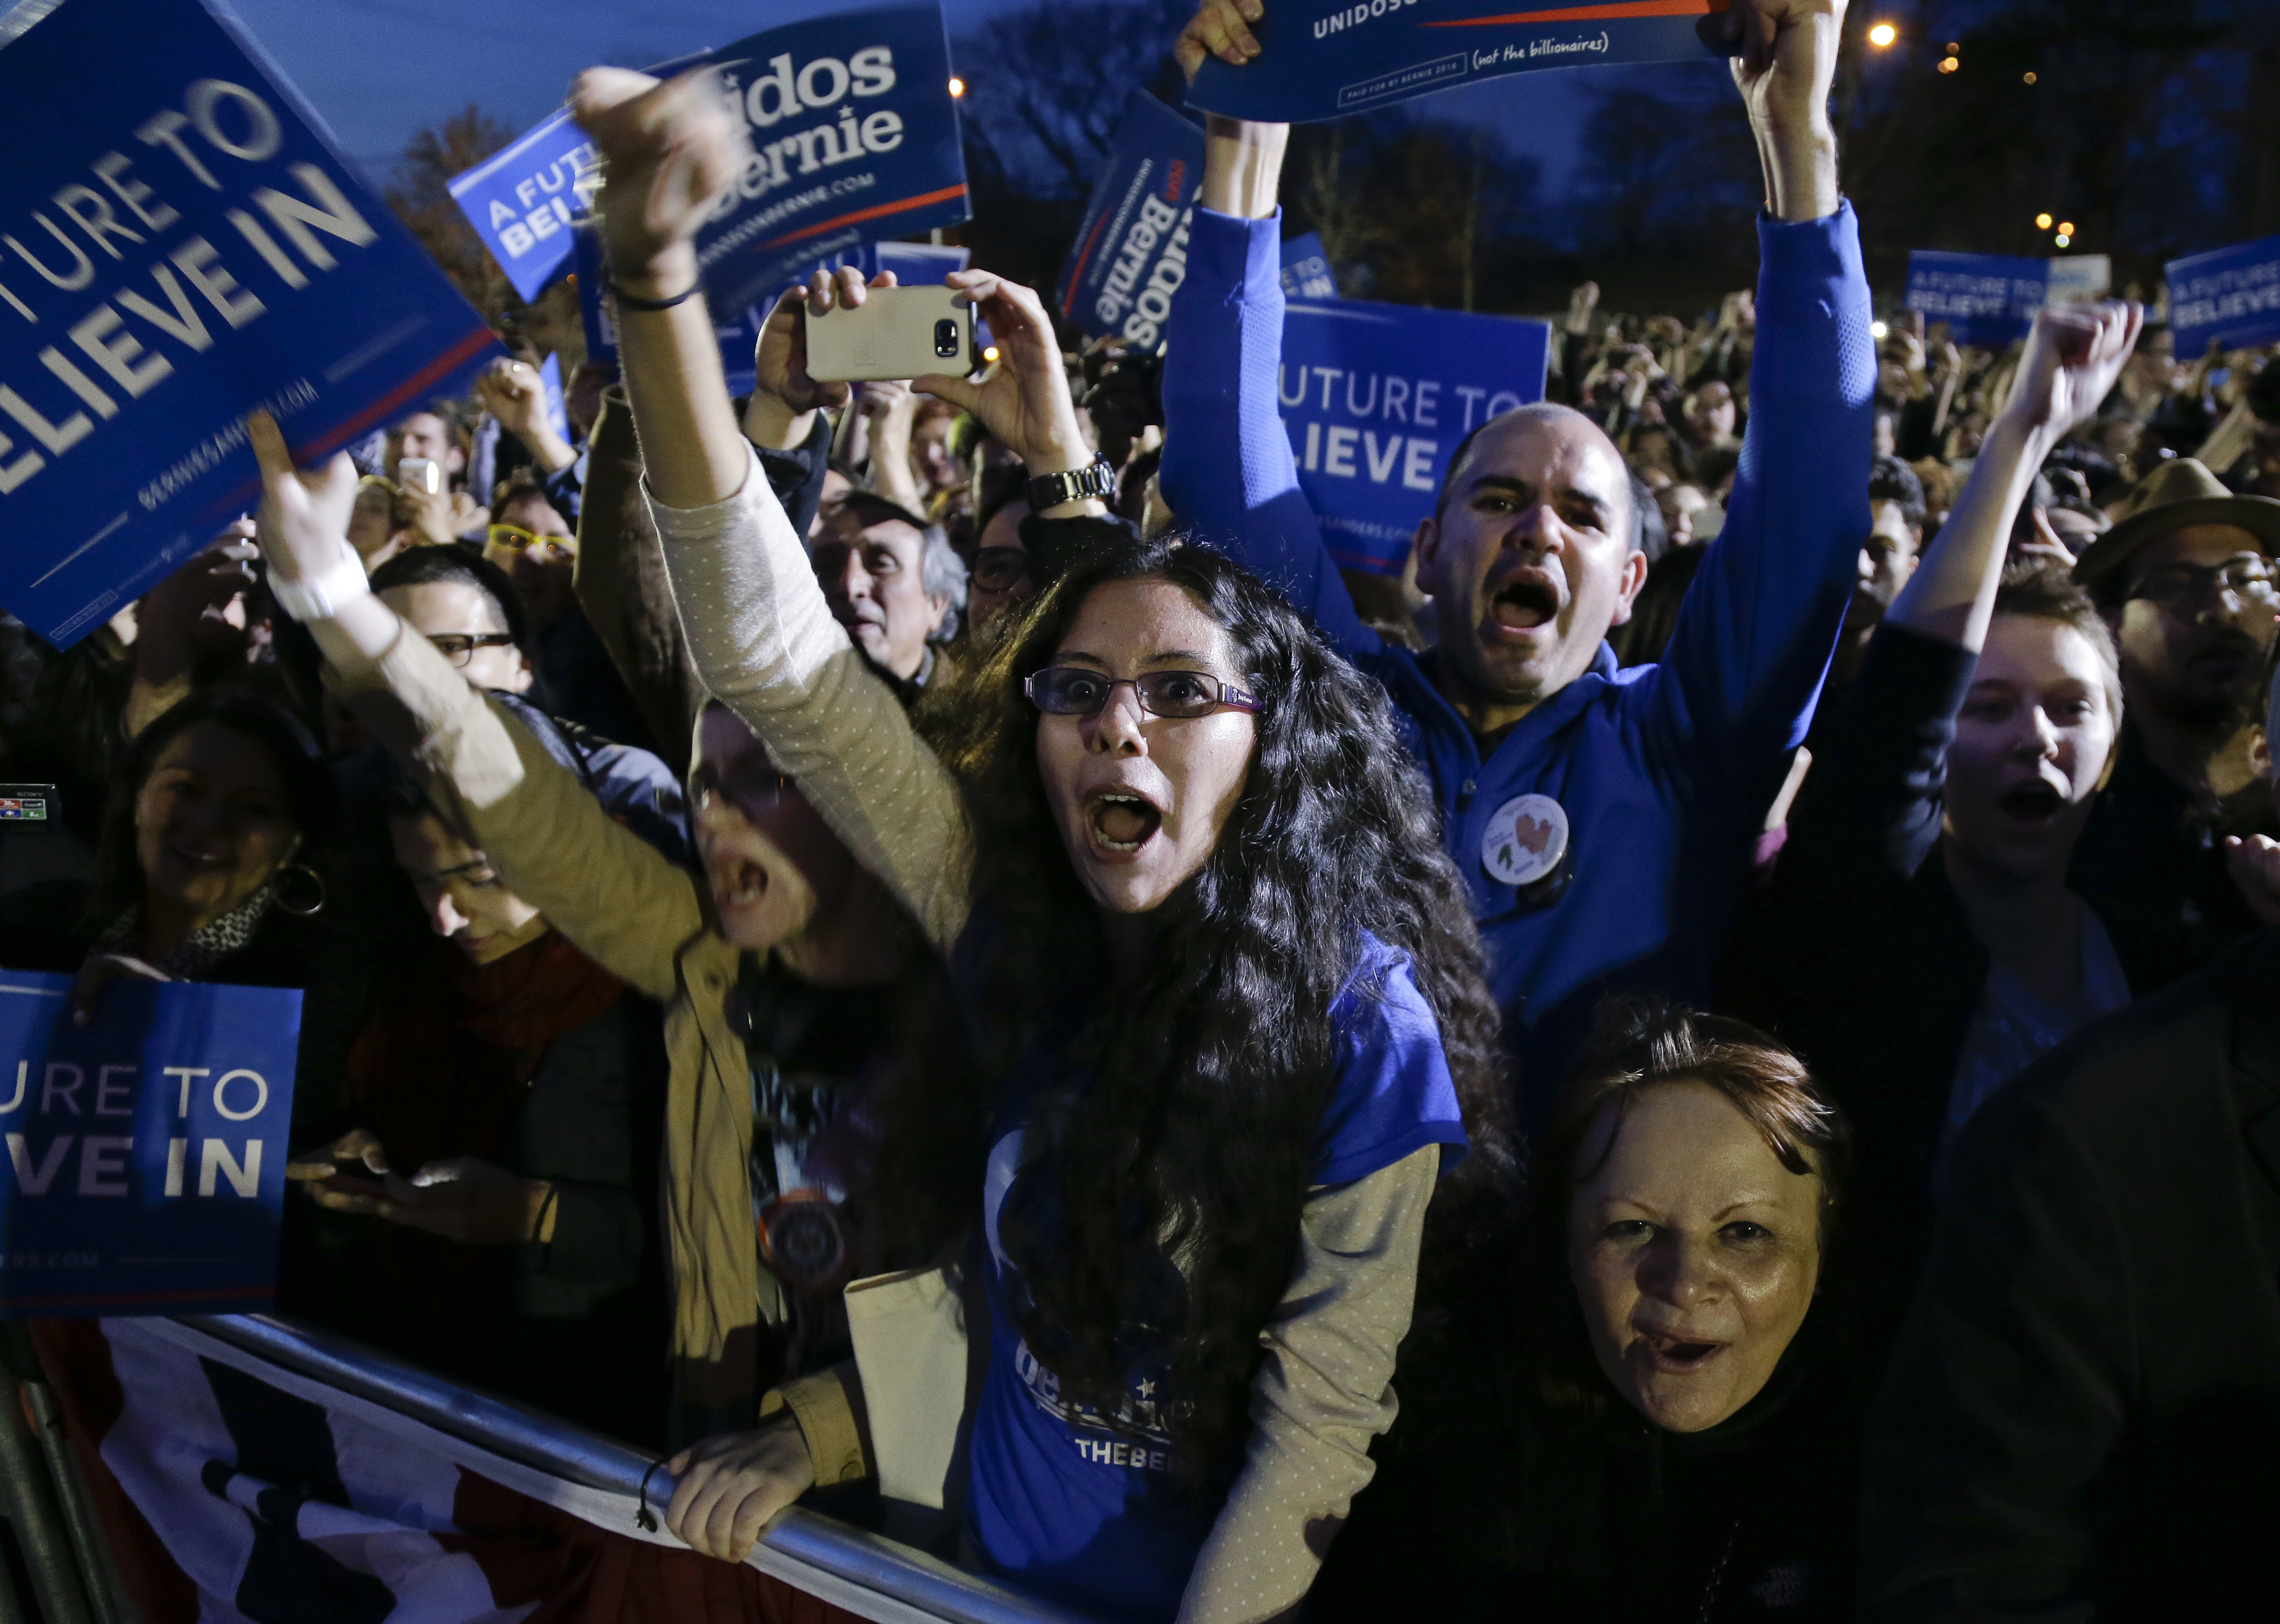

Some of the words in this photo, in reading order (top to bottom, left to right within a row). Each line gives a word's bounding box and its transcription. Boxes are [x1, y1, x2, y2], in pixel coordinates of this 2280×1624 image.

[1370, 82, 1385, 93] FOR
[1401, 68, 1432, 84] BERNIE
[1472, 48, 1499, 70] (not
[1503, 43, 1525, 61] the
[1529, 31, 1609, 56] billionaires)
[133, 78, 283, 191] TO
[711, 104, 904, 223] ernie
[224, 161, 380, 292] IN
[489, 199, 517, 231] A
[1095, 192, 1178, 325] Bernie
[1295, 422, 1438, 491] IEVE
[163, 1066, 268, 1121] TO
[164, 1137, 264, 1198] IN
[1768, 1563, 1798, 1581] THE
